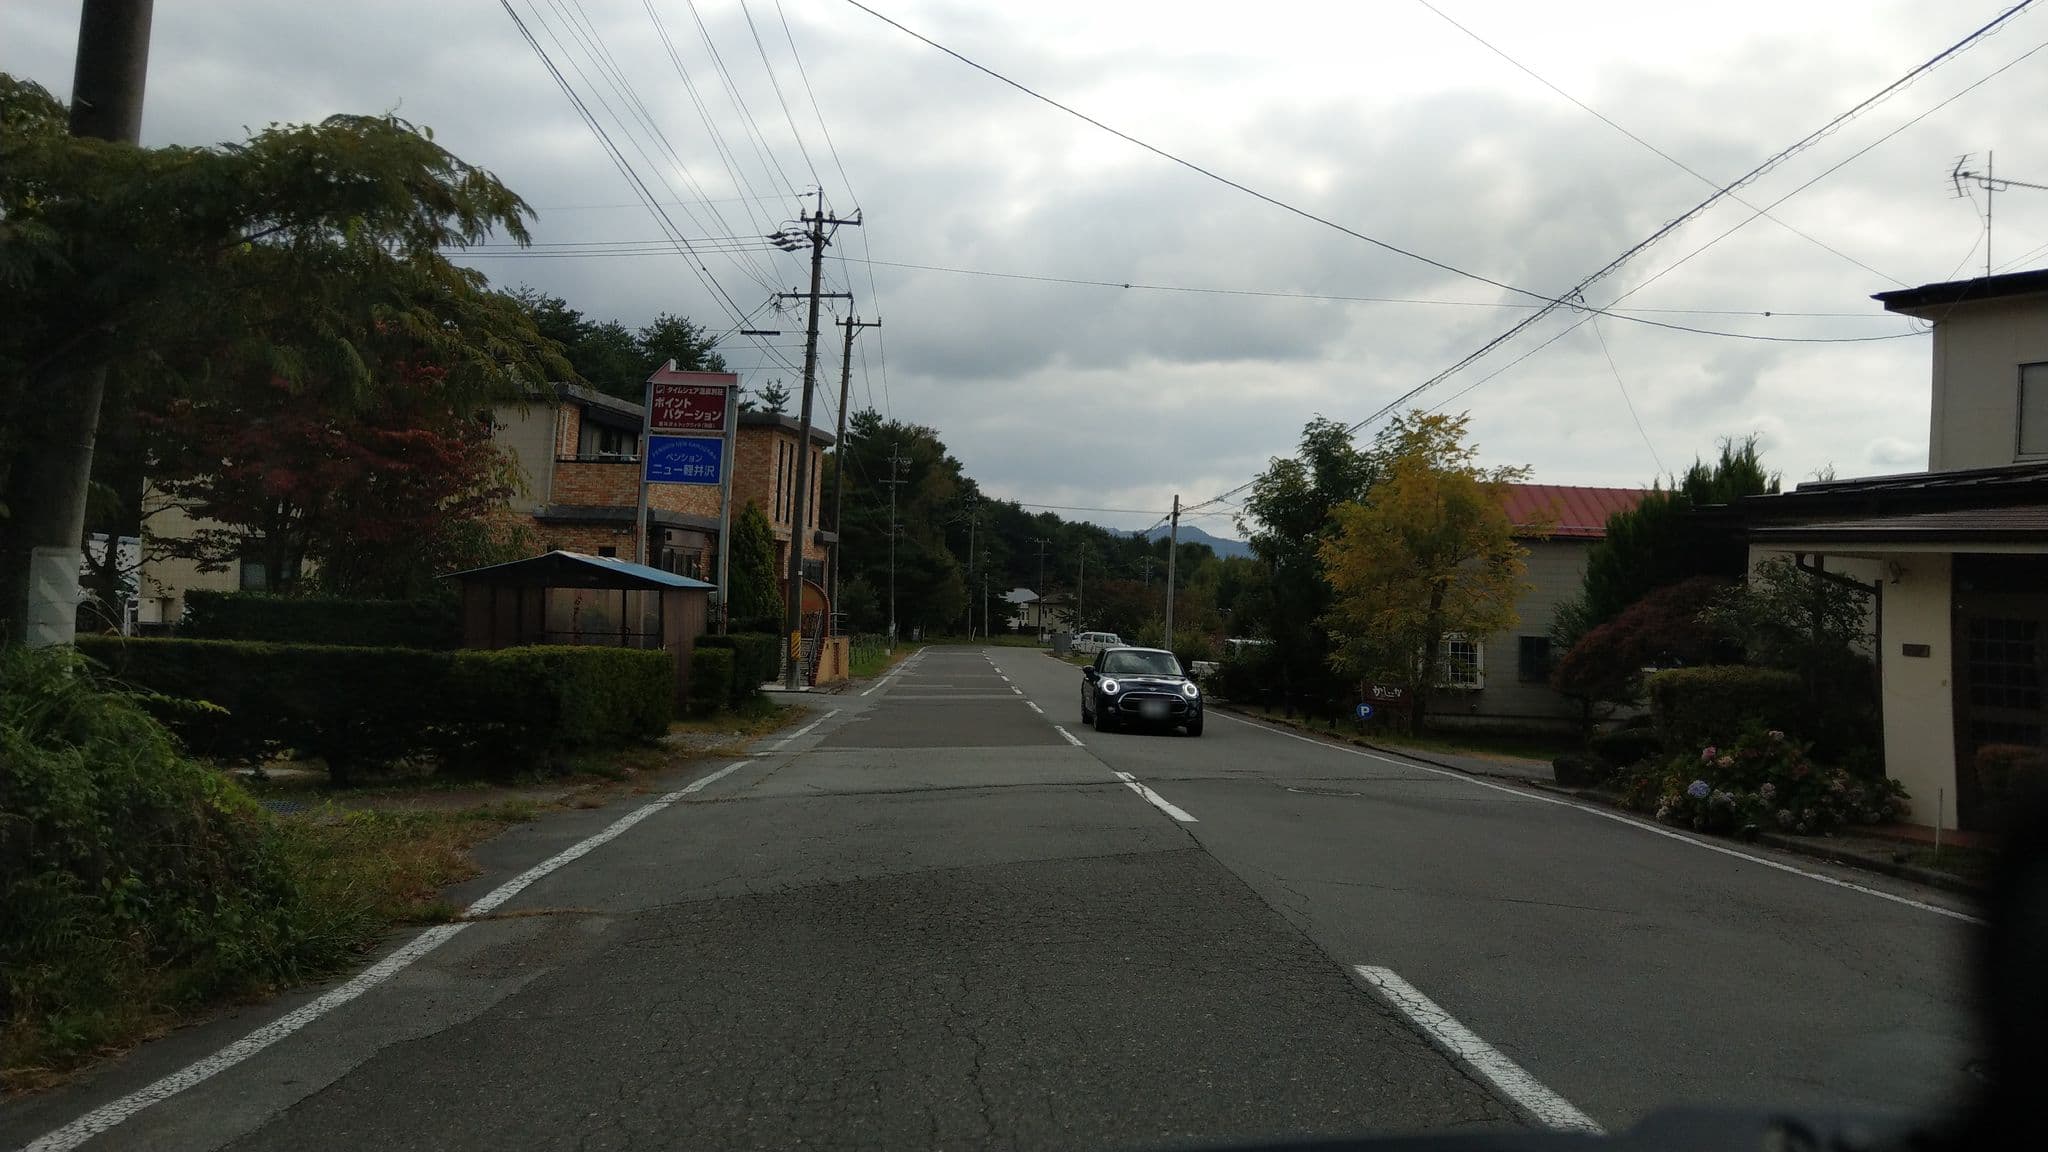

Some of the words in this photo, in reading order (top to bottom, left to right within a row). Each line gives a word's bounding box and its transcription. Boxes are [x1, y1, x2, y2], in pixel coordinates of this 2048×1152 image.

[654, 397, 692, 408] ポイント
[663, 408, 721, 421] バケーション
[666, 453, 703, 462] ペンション
[652, 464, 715, 477] ニュー軽井沢
[1360, 705, 1370, 716] P
